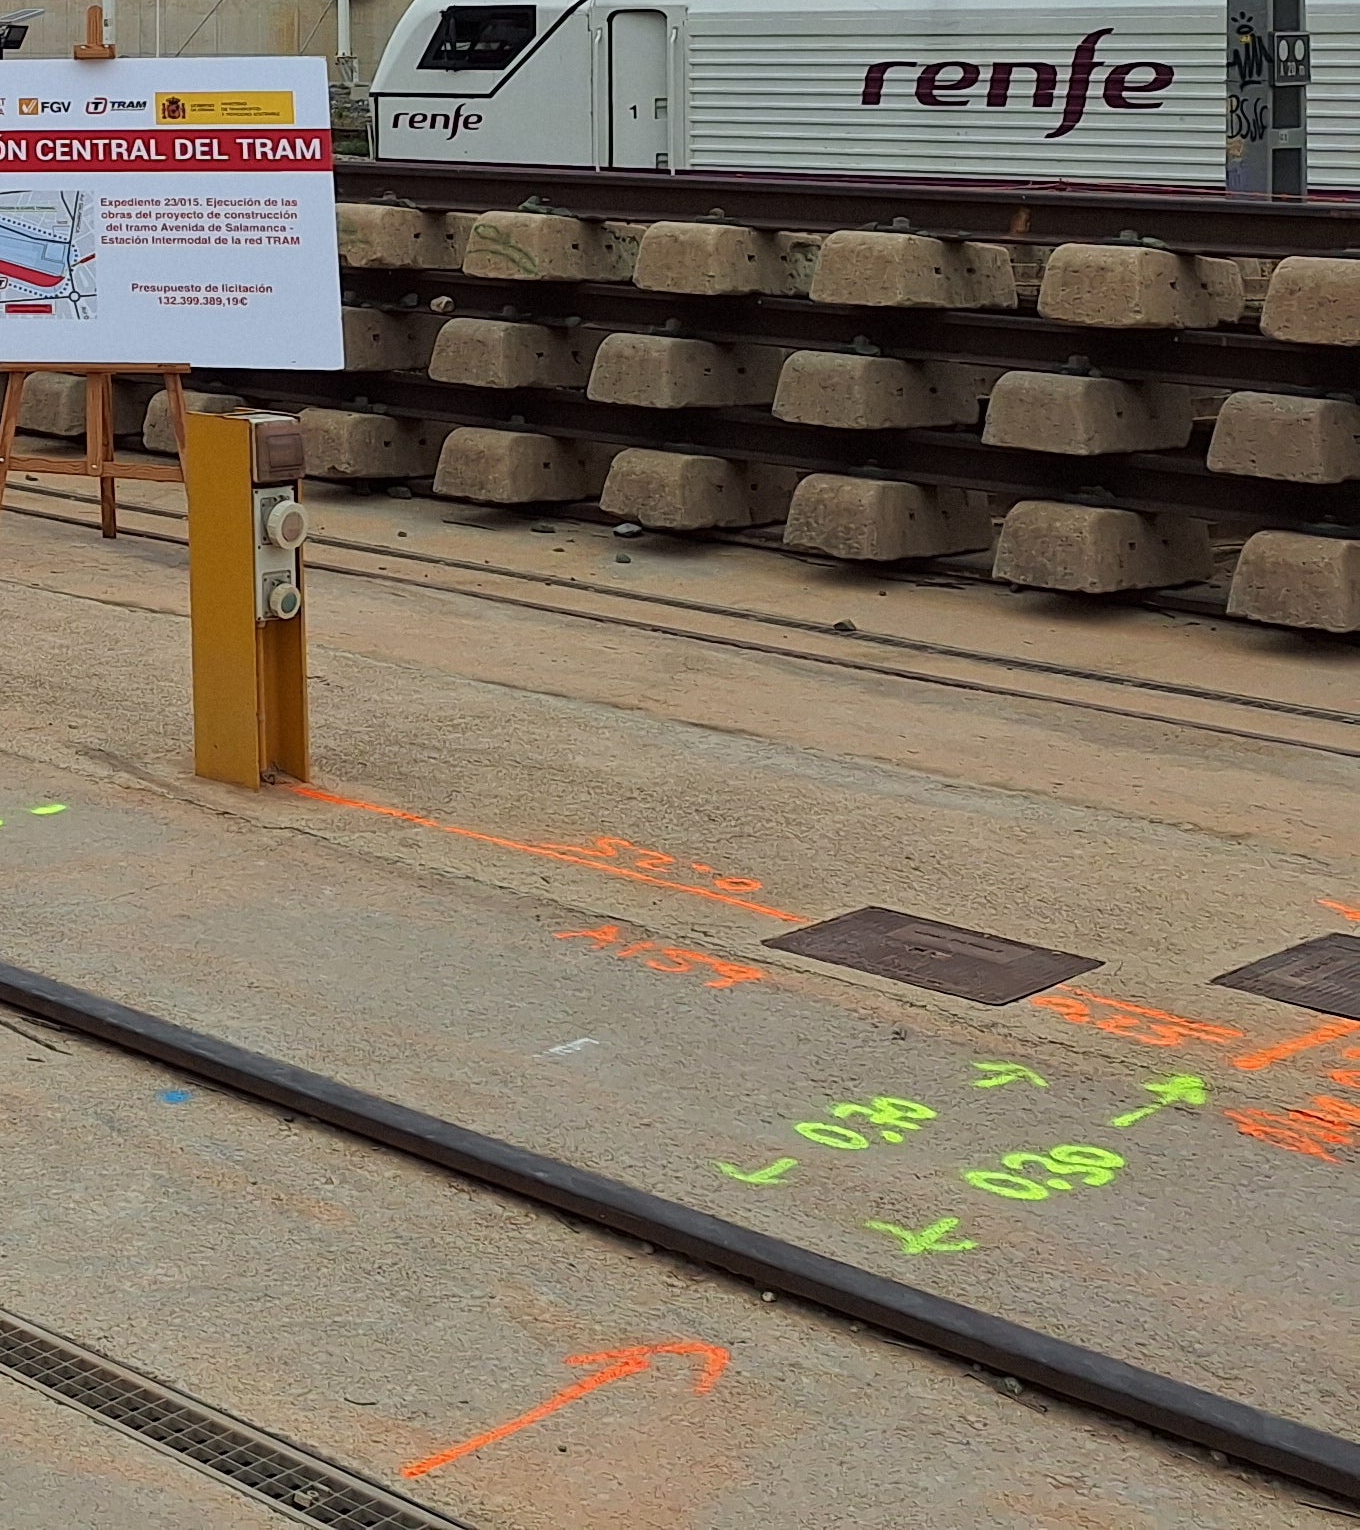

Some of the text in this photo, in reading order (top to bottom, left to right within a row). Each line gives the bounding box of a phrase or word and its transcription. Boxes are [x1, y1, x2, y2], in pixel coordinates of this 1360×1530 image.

[860, 27, 1175, 140] renfe
[40, 101, 72, 113] FGV
[109, 100, 148, 111] TRAM
[628, 104, 638, 120] 1
[391, 102, 483, 141] renfe
[35, 137, 166, 162] CENTRAL
[174, 137, 229, 160] DEL
[235, 137, 322, 160] TRAM
[100, 197, 298, 209] Expediente 23/015. Ejecución de las
[101, 210, 298, 221] obras del proyecto de construcción
[105, 223, 123, 232] del
[125, 223, 158, 232] tramo
[160, 223, 205, 232] Avenida
[208, 223, 222, 232] de
[225, 223, 287, 232] Salamanca
[101, 235, 301, 245] Estación Intermodal de la red TRAM
[131, 282, 273, 294] Presupuesto de licitación
[157, 296, 248, 307] 132.399.389,19€
[963, 1143, 1126, 1201] 0.30
